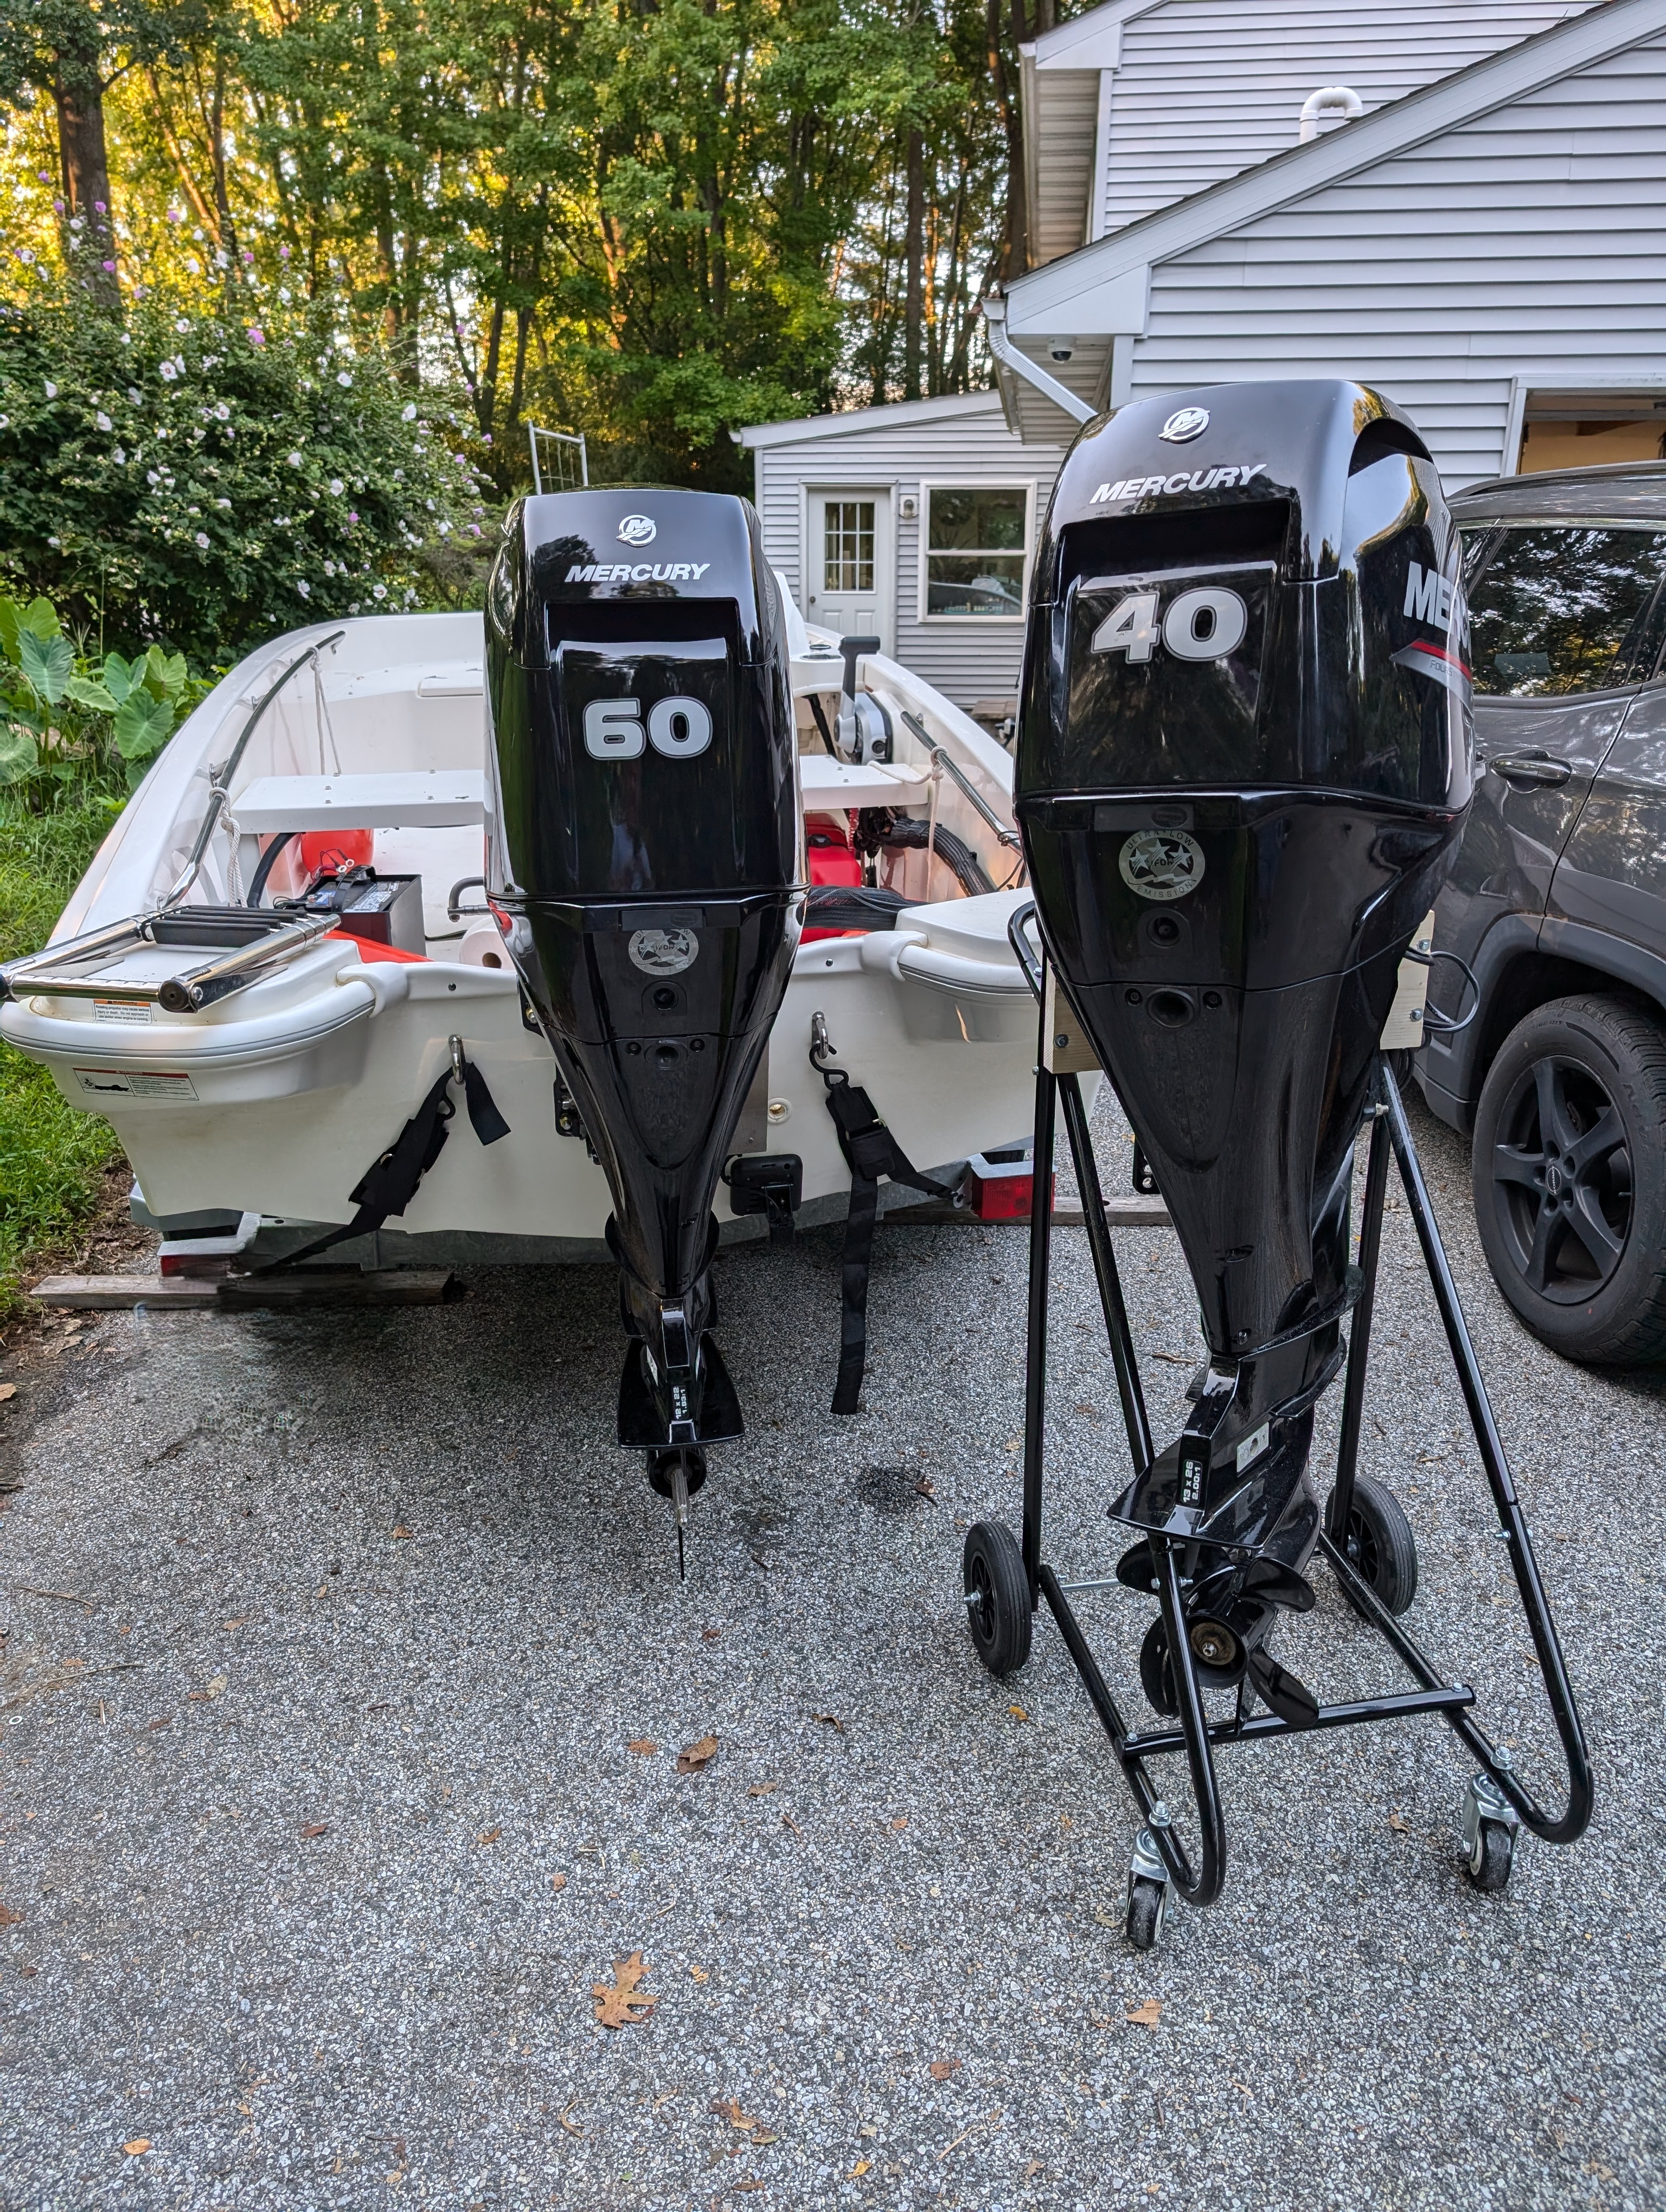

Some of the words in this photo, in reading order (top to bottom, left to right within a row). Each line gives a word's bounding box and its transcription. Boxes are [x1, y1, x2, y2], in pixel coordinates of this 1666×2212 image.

[1089, 464, 1267, 504] MERCURY
[565, 564, 710, 582] MERCURY
[1091, 586, 1248, 664] 40
[582, 696, 713, 760] 60
[1170, 830, 1194, 846] LOW
[1137, 881, 1193, 898] EMISSION
[673, 1387, 680, 1400] 22
[675, 1408, 681, 1419] 12
[1185, 1461, 1194, 1478] 26
[1192, 1467, 1201, 1500] 2.00:1
[1183, 1488, 1191, 1503] 13
